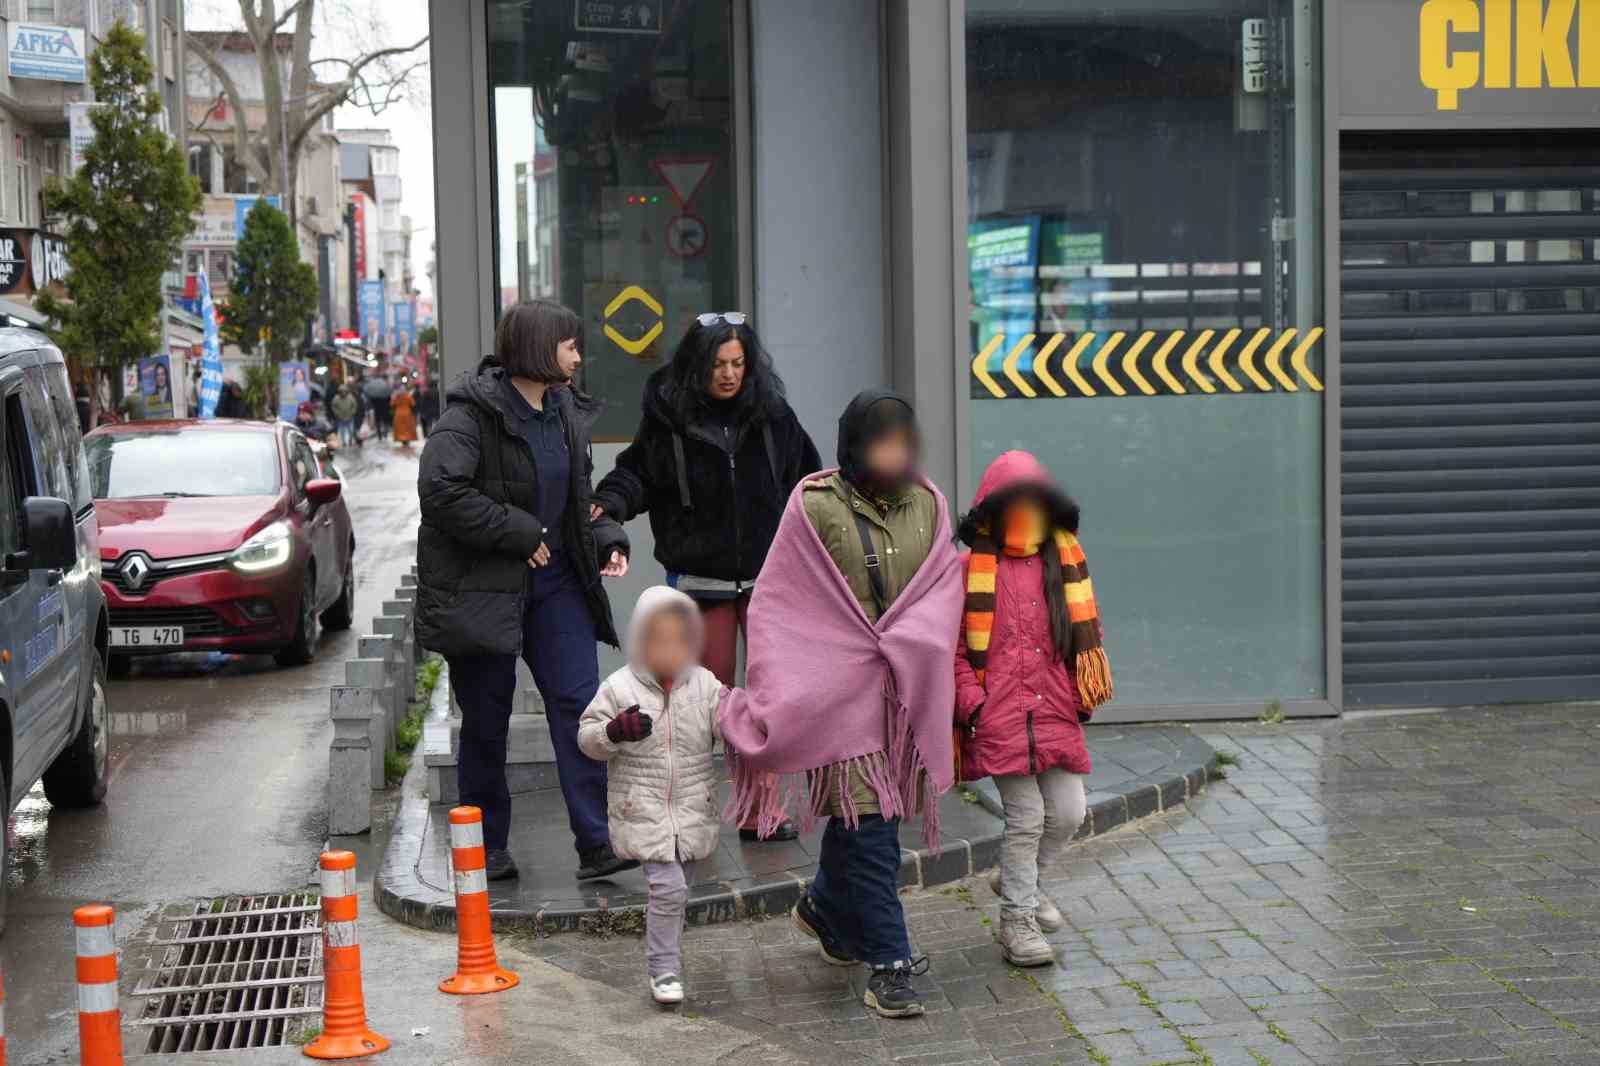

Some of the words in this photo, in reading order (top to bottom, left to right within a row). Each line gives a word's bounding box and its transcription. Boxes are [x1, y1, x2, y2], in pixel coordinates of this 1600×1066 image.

[14, 31, 79, 56] AFKA
[123, 629, 140, 644] TG
[153, 628, 180, 643] 470
